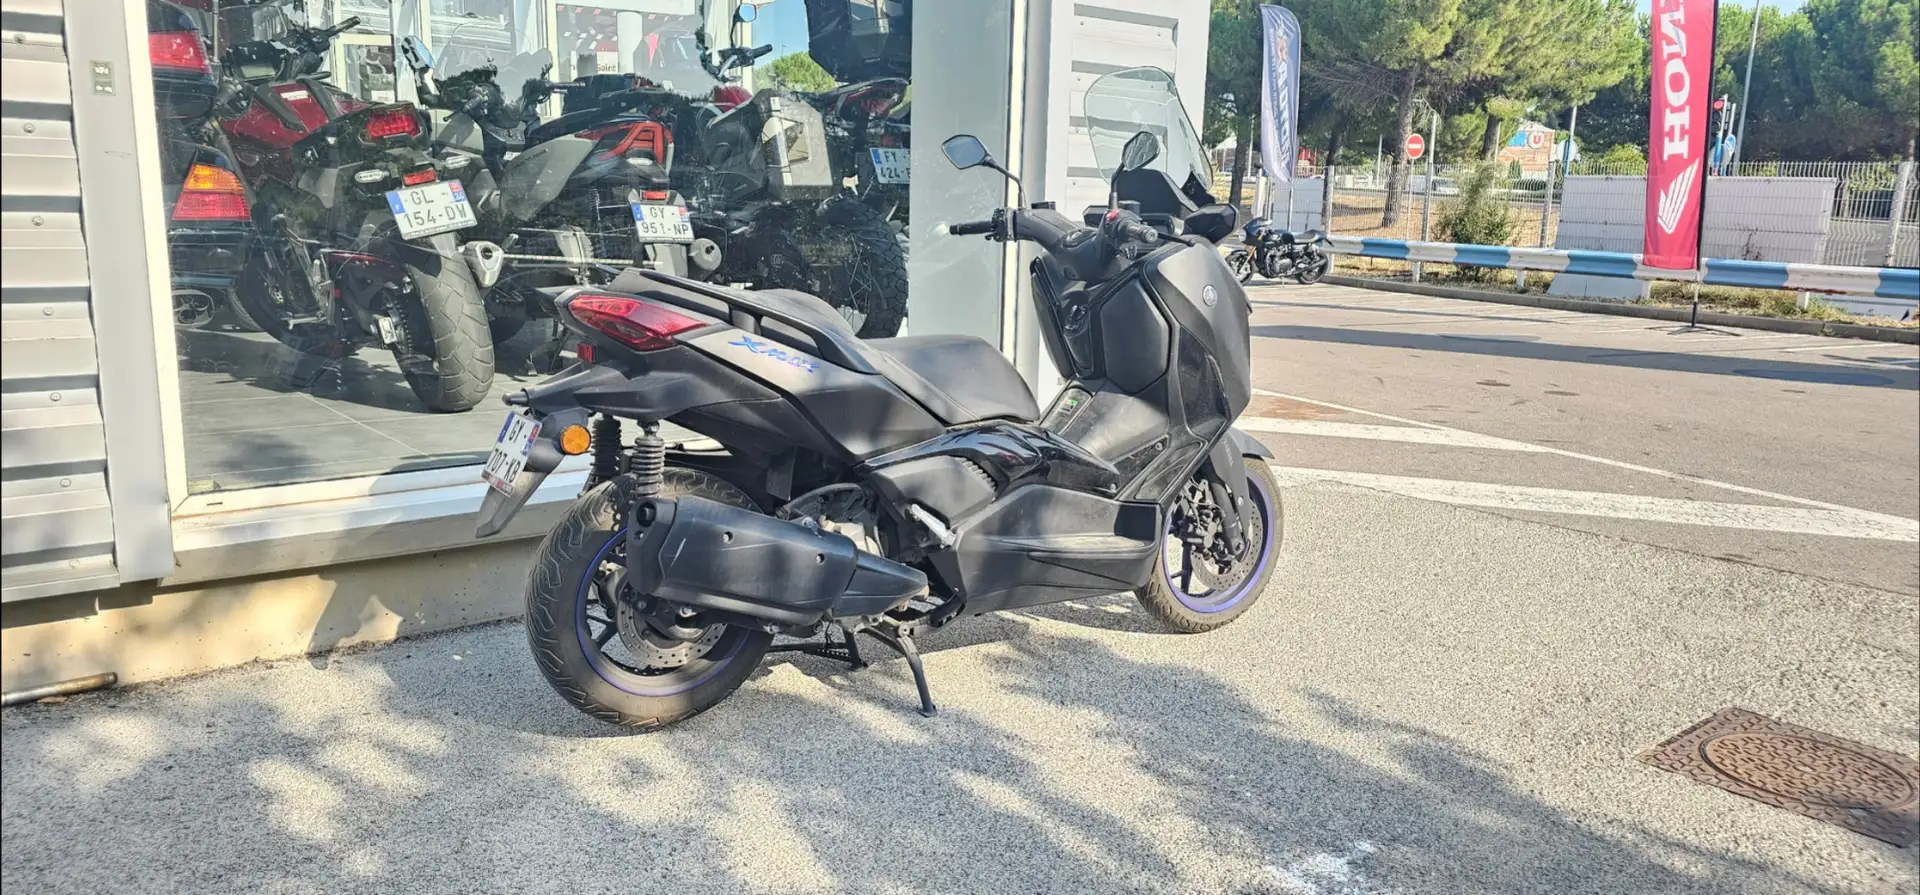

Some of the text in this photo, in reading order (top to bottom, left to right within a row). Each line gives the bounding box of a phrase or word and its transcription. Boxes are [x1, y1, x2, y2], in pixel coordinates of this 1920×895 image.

[404, 203, 467, 228] 154-DW
[641, 222, 689, 235] 951-NP
[487, 448, 521, 483] 707-KB
